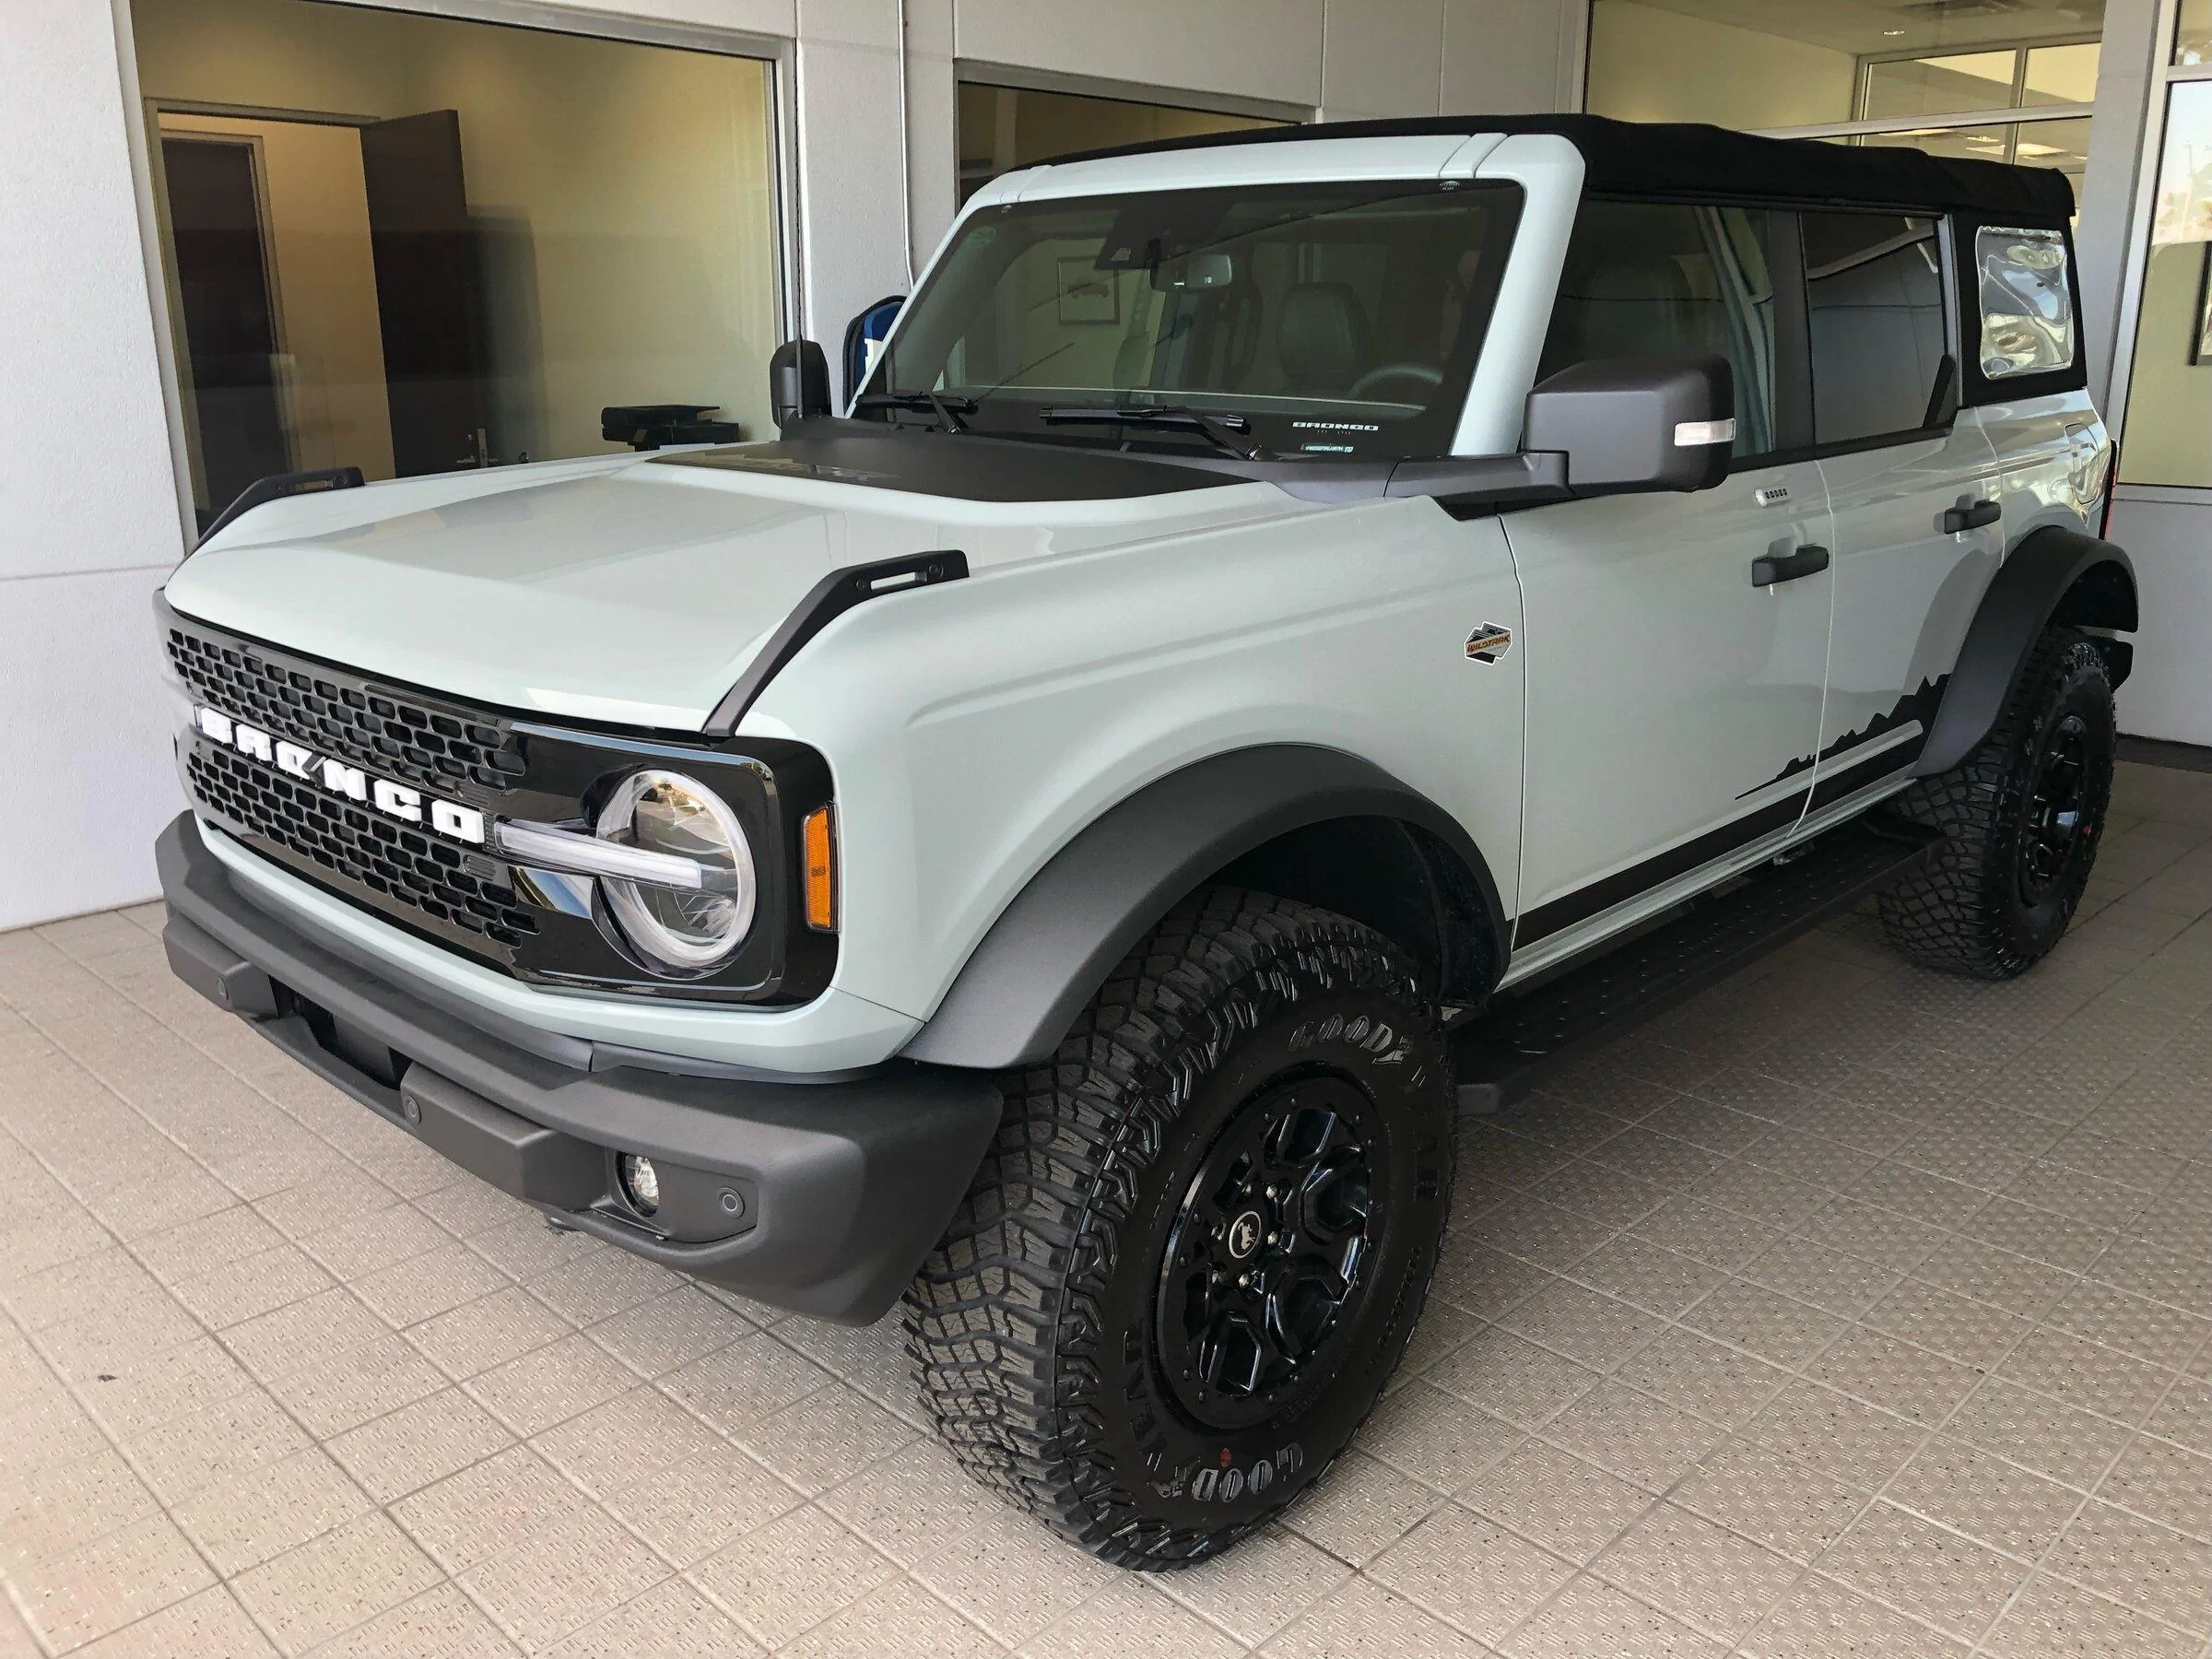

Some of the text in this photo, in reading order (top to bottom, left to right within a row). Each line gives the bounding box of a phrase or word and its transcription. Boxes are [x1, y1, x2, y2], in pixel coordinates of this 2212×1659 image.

[1293, 421, 1379, 431] BRONCO
[1466, 635, 1510, 653] WILDTRAK
[201, 707, 485, 844] BRONCO
